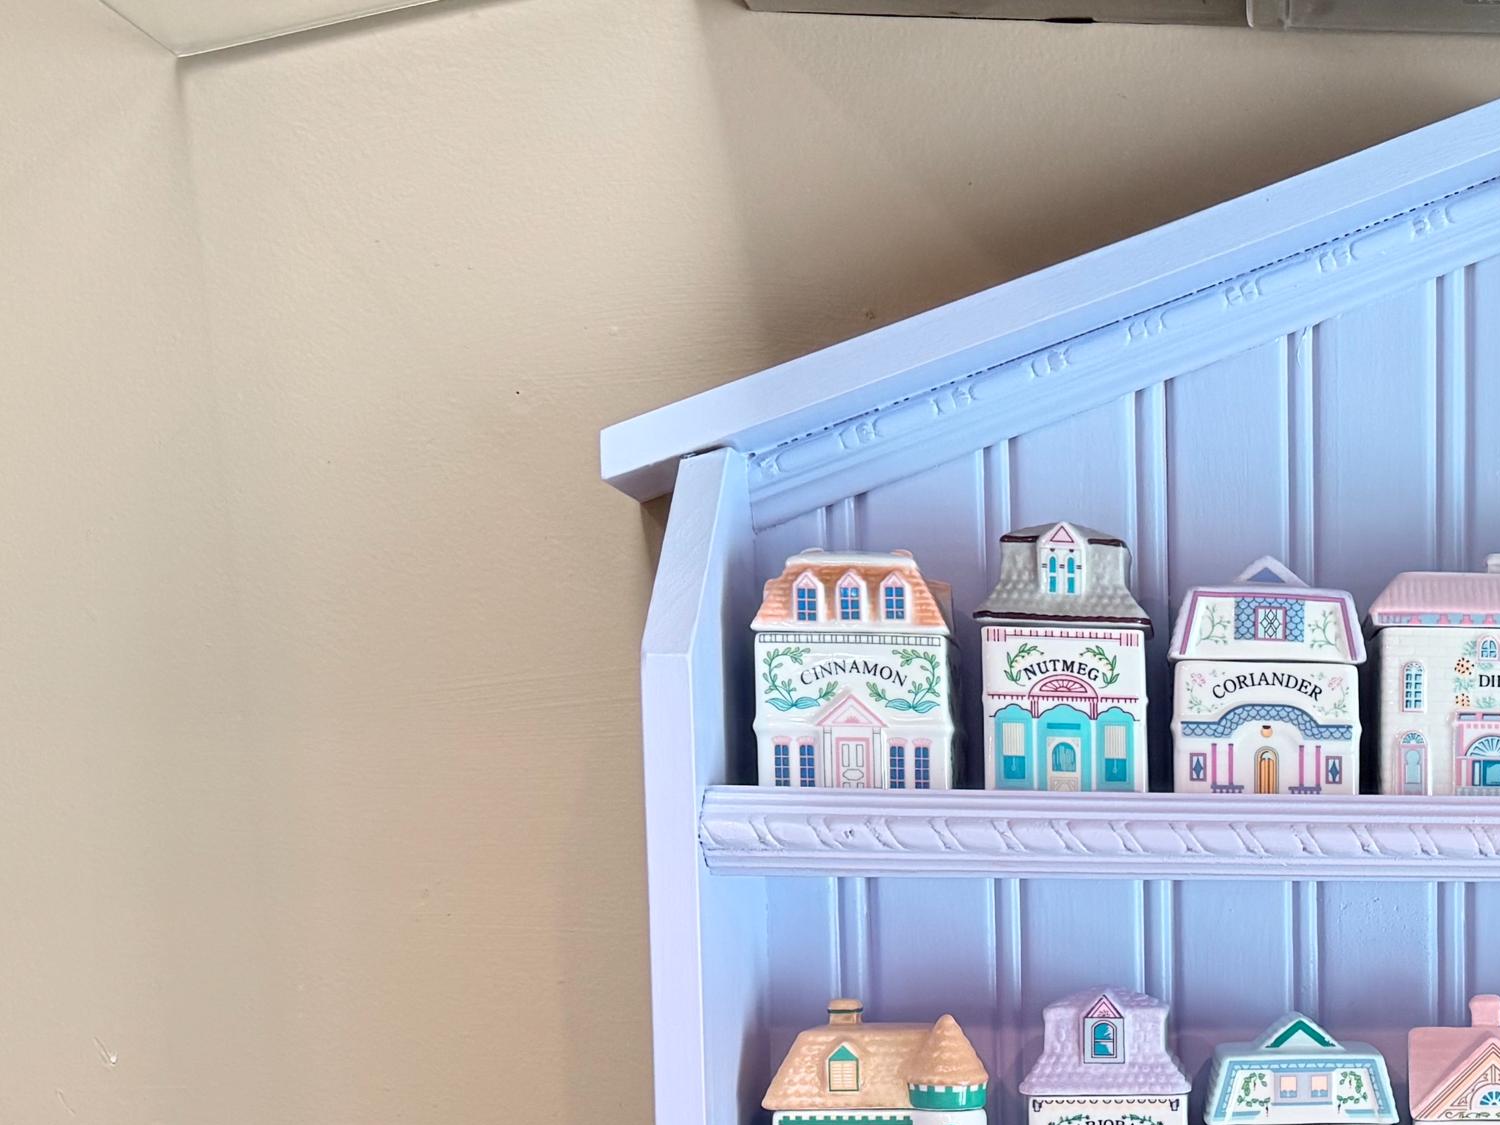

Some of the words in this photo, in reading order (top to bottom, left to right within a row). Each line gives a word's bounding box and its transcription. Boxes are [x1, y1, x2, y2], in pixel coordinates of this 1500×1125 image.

[799, 658, 908, 688] CINNAMON
[1023, 658, 1099, 683] NUTMEG
[1211, 671, 1323, 702] CORIANDER
